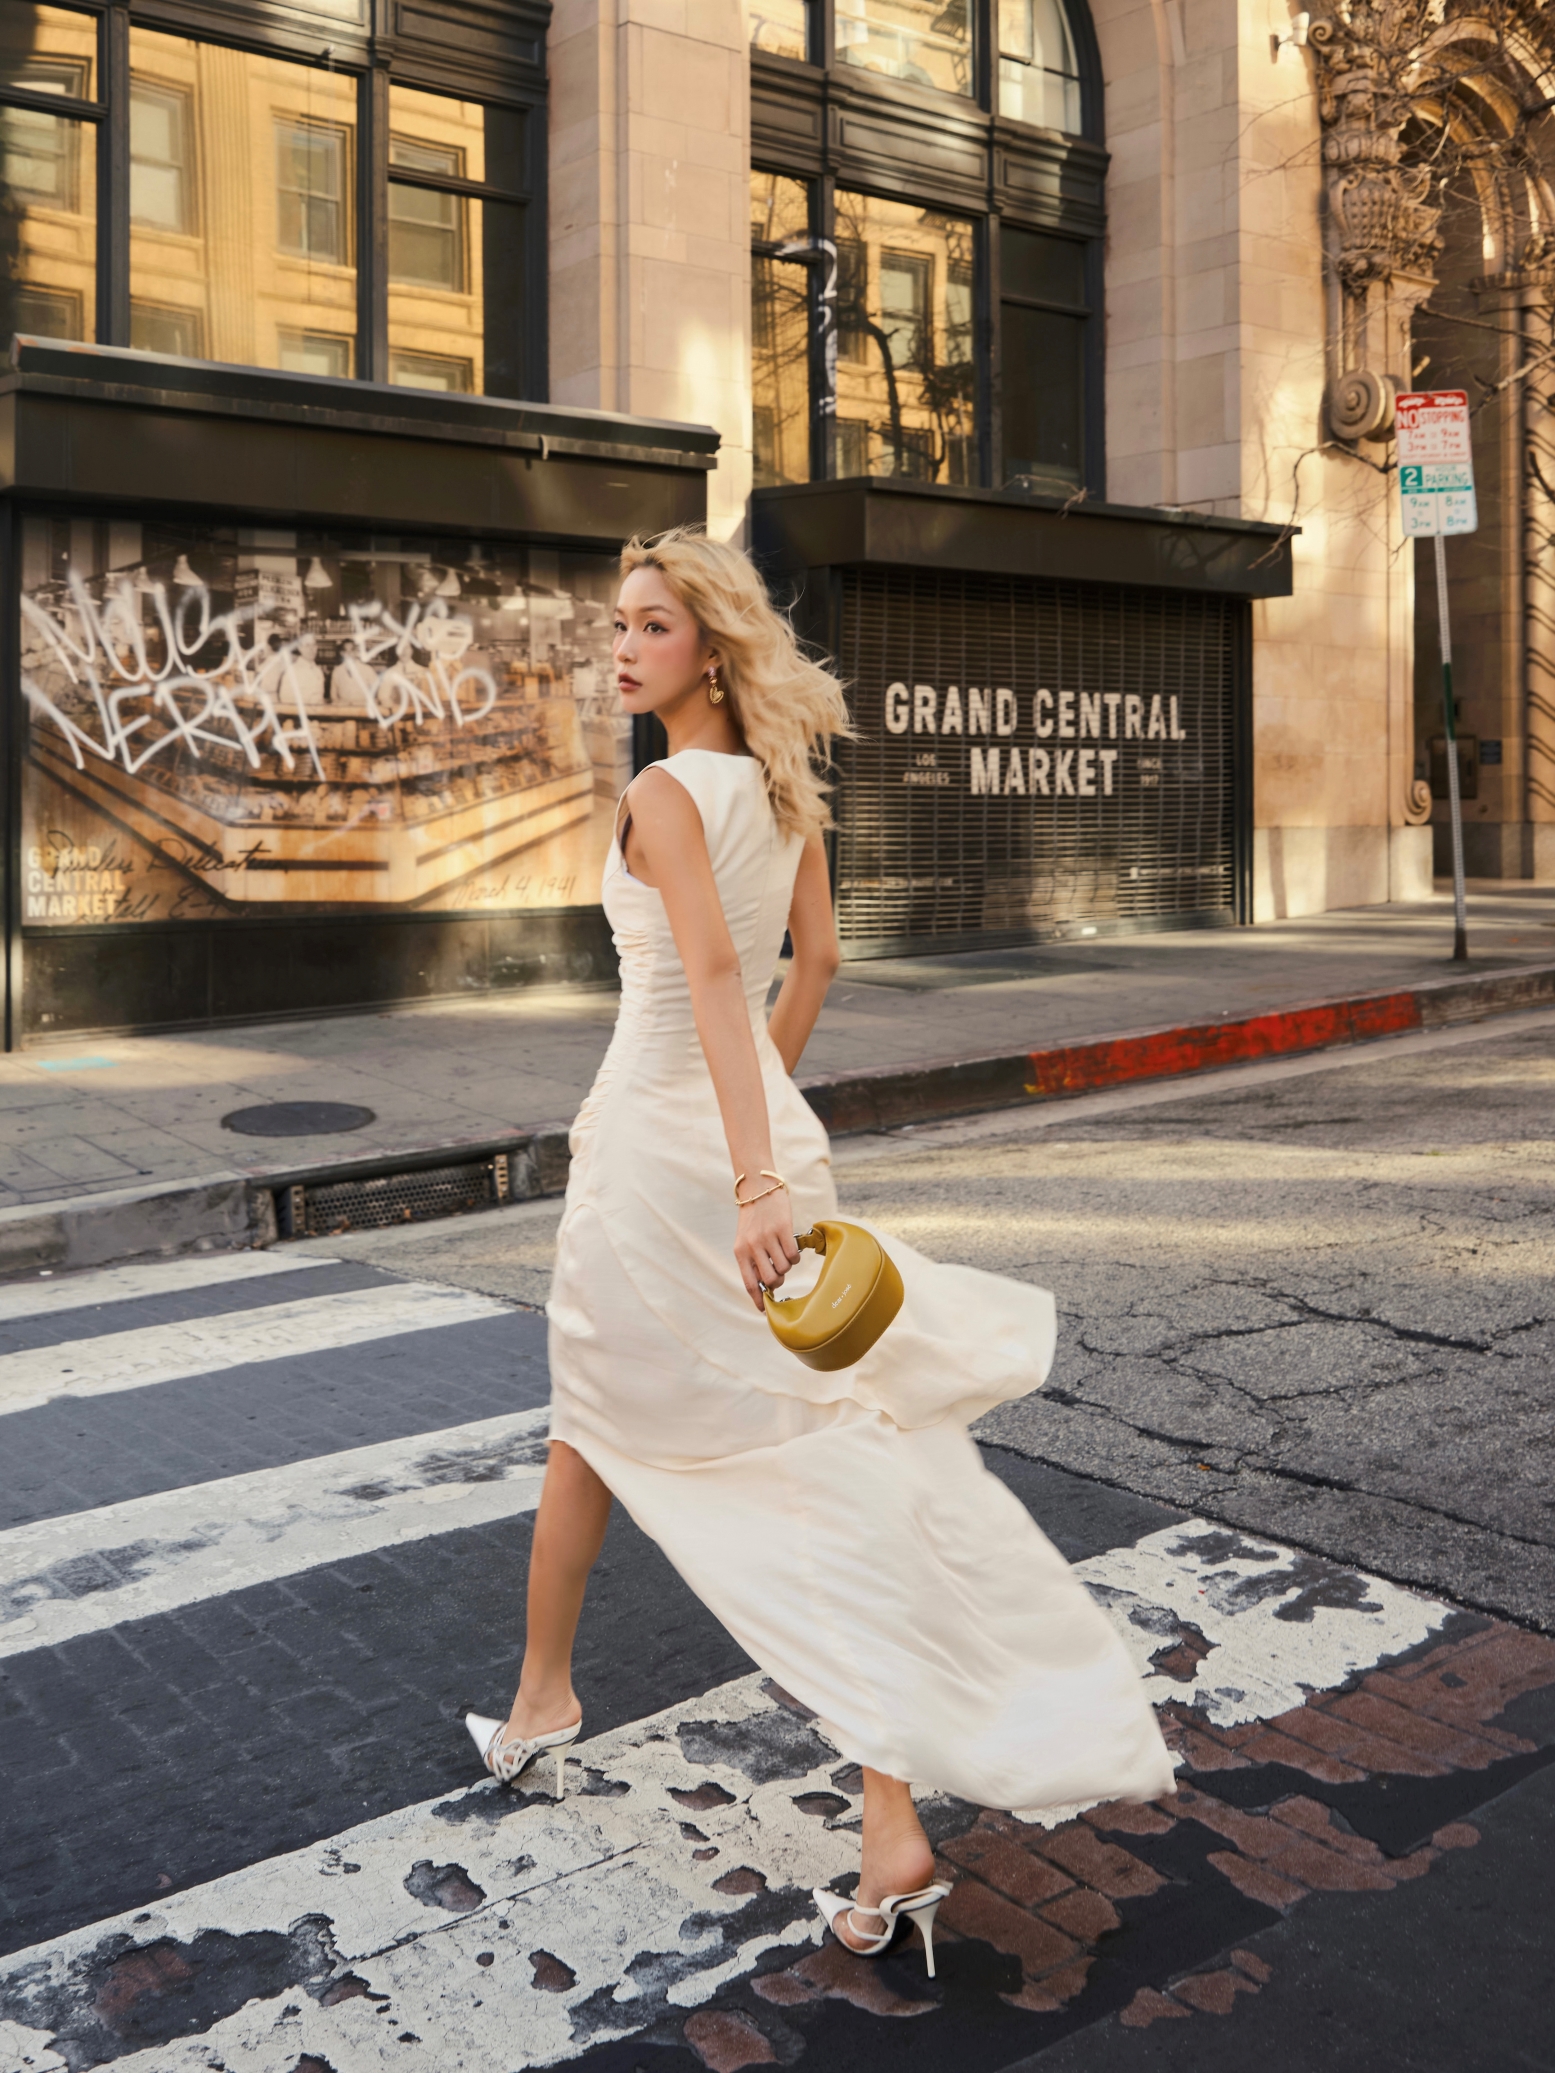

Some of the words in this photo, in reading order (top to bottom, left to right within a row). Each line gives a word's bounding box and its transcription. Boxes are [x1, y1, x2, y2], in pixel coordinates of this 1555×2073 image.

[1397, 409, 1420, 429] NO
[1420, 410, 1465, 424] STOPPING
[1404, 467, 1418, 487] 2
[1425, 472, 1468, 486] PARKING
[885, 682, 1018, 737] GRAND
[1033, 688, 1187, 741] CENTRAL
[970, 747, 1118, 796] MARKET
[27, 870, 126, 893] CENTRAL
[27, 894, 117, 917] MARKET
[832, 1297, 842, 1308] dear
